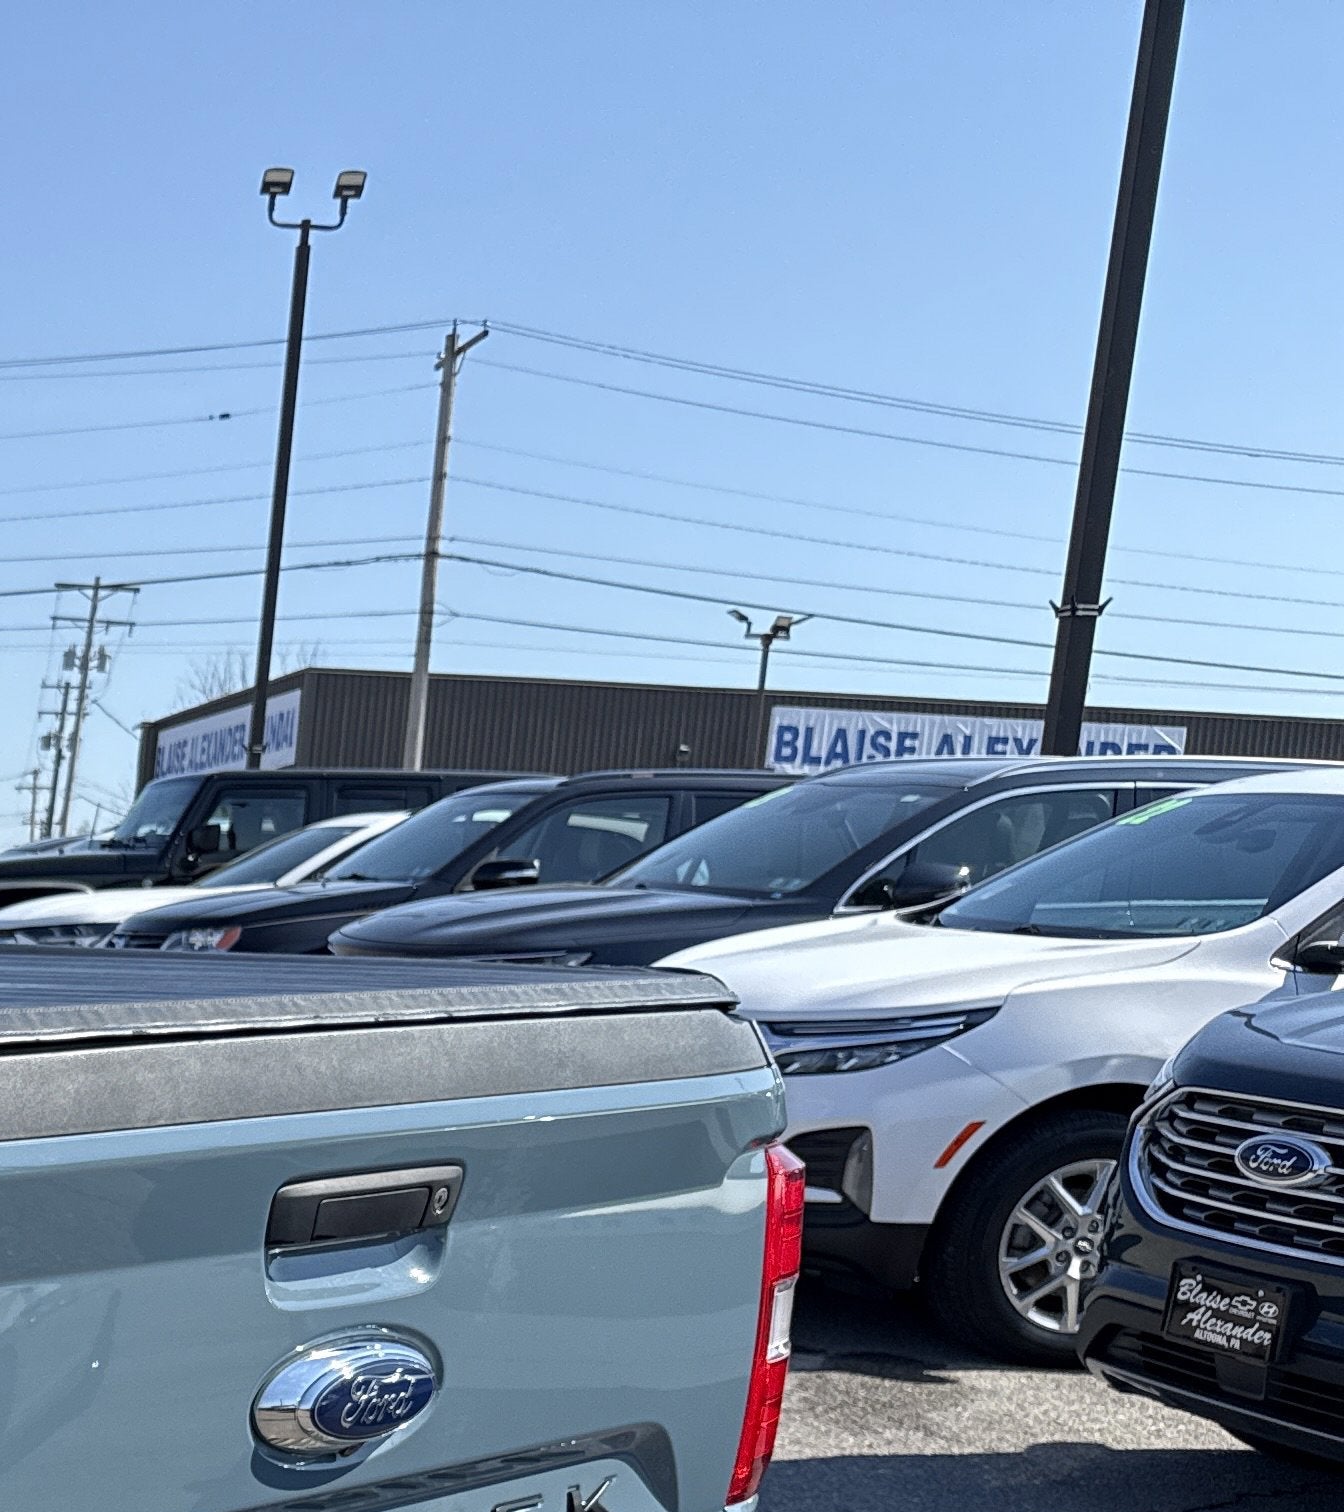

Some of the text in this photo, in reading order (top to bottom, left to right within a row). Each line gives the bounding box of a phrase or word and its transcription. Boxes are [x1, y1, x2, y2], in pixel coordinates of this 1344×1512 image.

[187, 723, 246, 772] ALEXANDER
[773, 725, 920, 765] BLAISE
[1249, 1144, 1297, 1174] Ford
[1177, 1278, 1231, 1311] Blaise
[1181, 1306, 1272, 1345] Alexander
[341, 1369, 416, 1429] Ford
